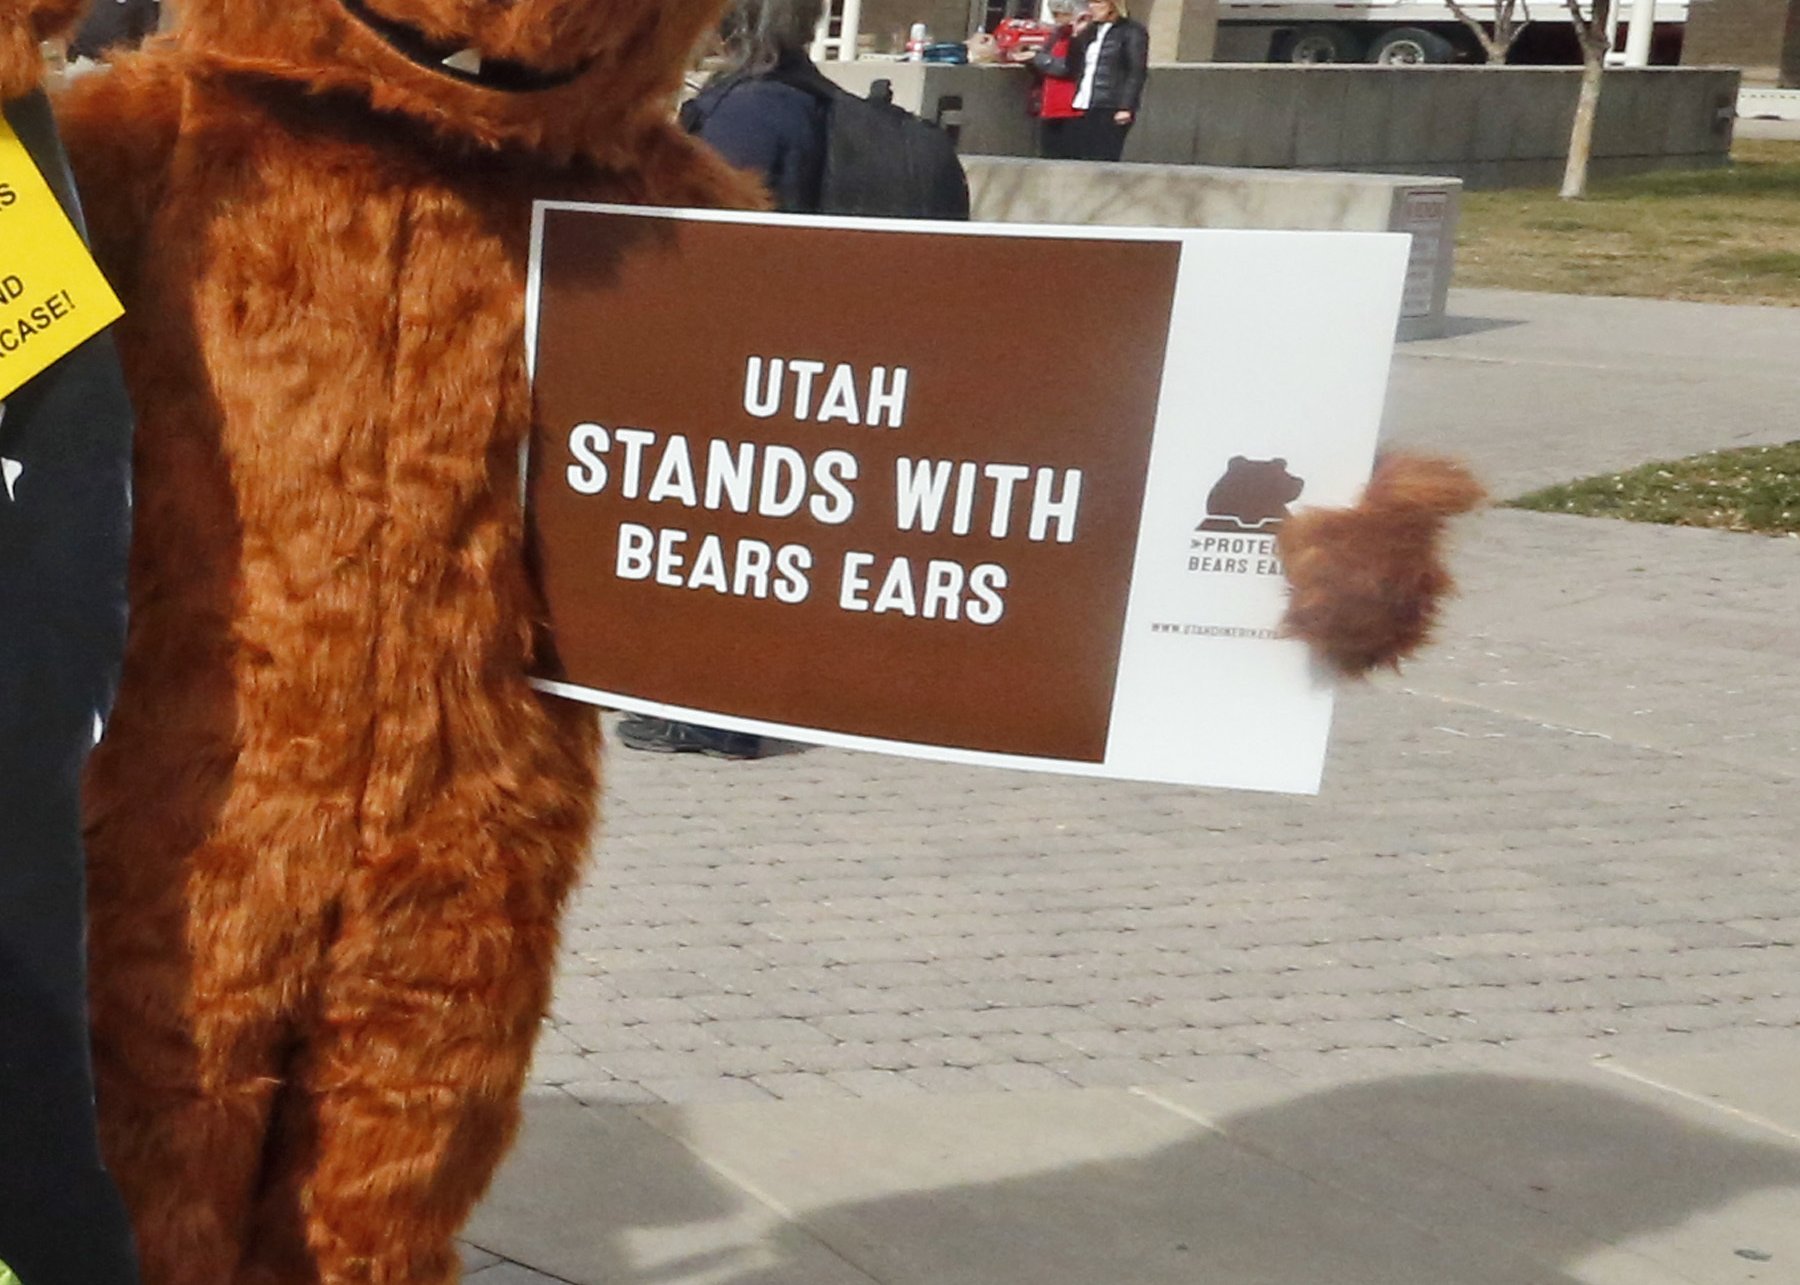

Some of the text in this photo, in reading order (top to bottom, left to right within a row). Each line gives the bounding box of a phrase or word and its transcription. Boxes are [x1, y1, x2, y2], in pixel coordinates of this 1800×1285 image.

[744, 355, 908, 428] UTAH
[566, 423, 1083, 544] STANDS WITH
[615, 522, 1008, 626] BEARS EARS
[1188, 556, 1248, 574] BEARS
[1204, 537, 1277, 555] PROTE
